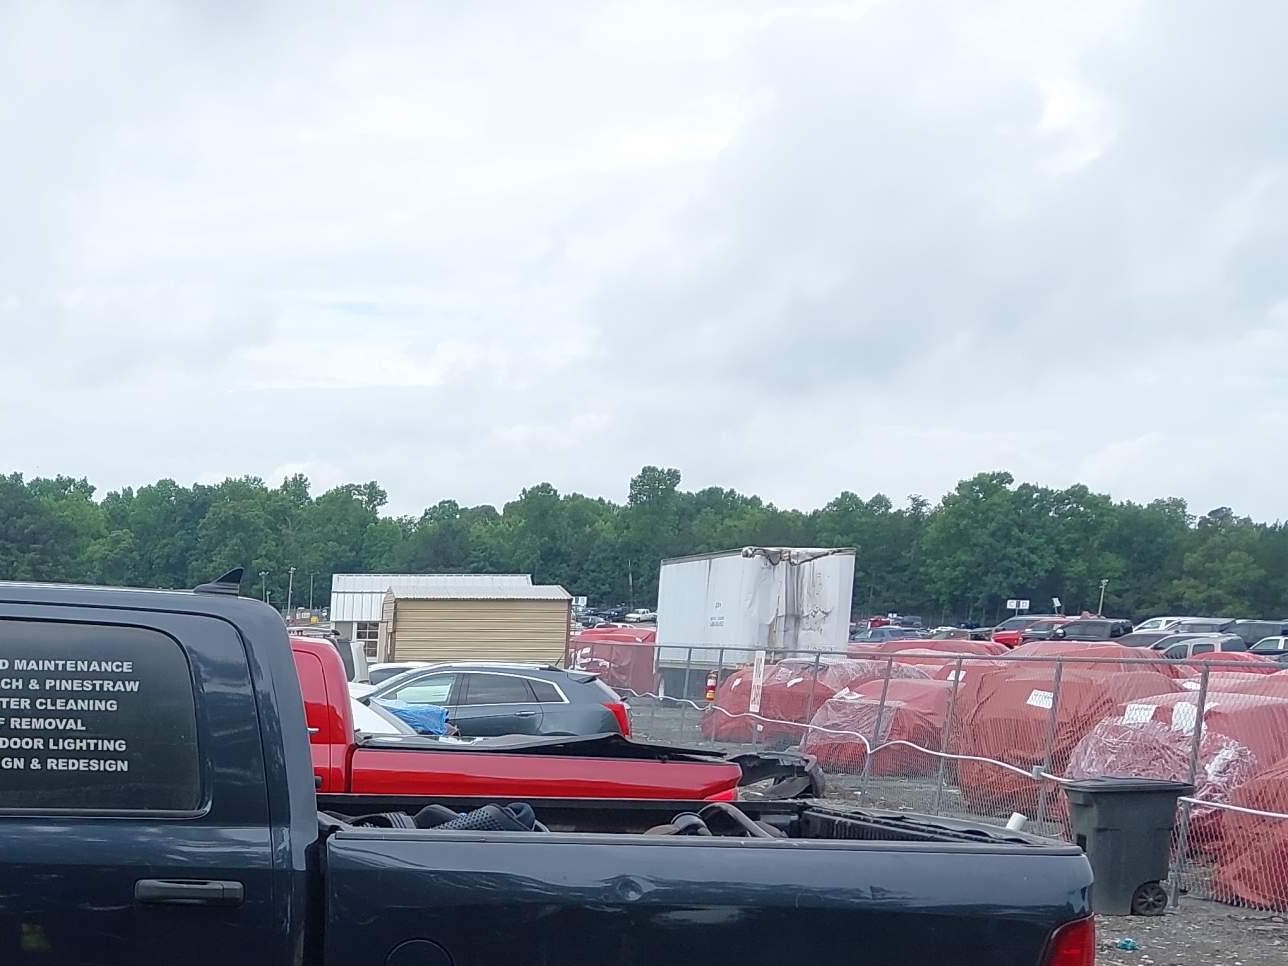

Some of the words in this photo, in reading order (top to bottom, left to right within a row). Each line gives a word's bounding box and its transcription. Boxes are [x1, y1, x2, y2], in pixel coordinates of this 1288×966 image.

[14, 659, 133, 672] MAINTENANCE
[28, 679, 40, 690] &
[45, 679, 140, 692] PINESTRAW
[36, 698, 118, 711] CLEANING
[10, 718, 86, 730] REMOVAL
[49, 738, 127, 751] LIGHTING
[30, 758, 41, 770] &
[46, 759, 129, 772] REDESIGN
